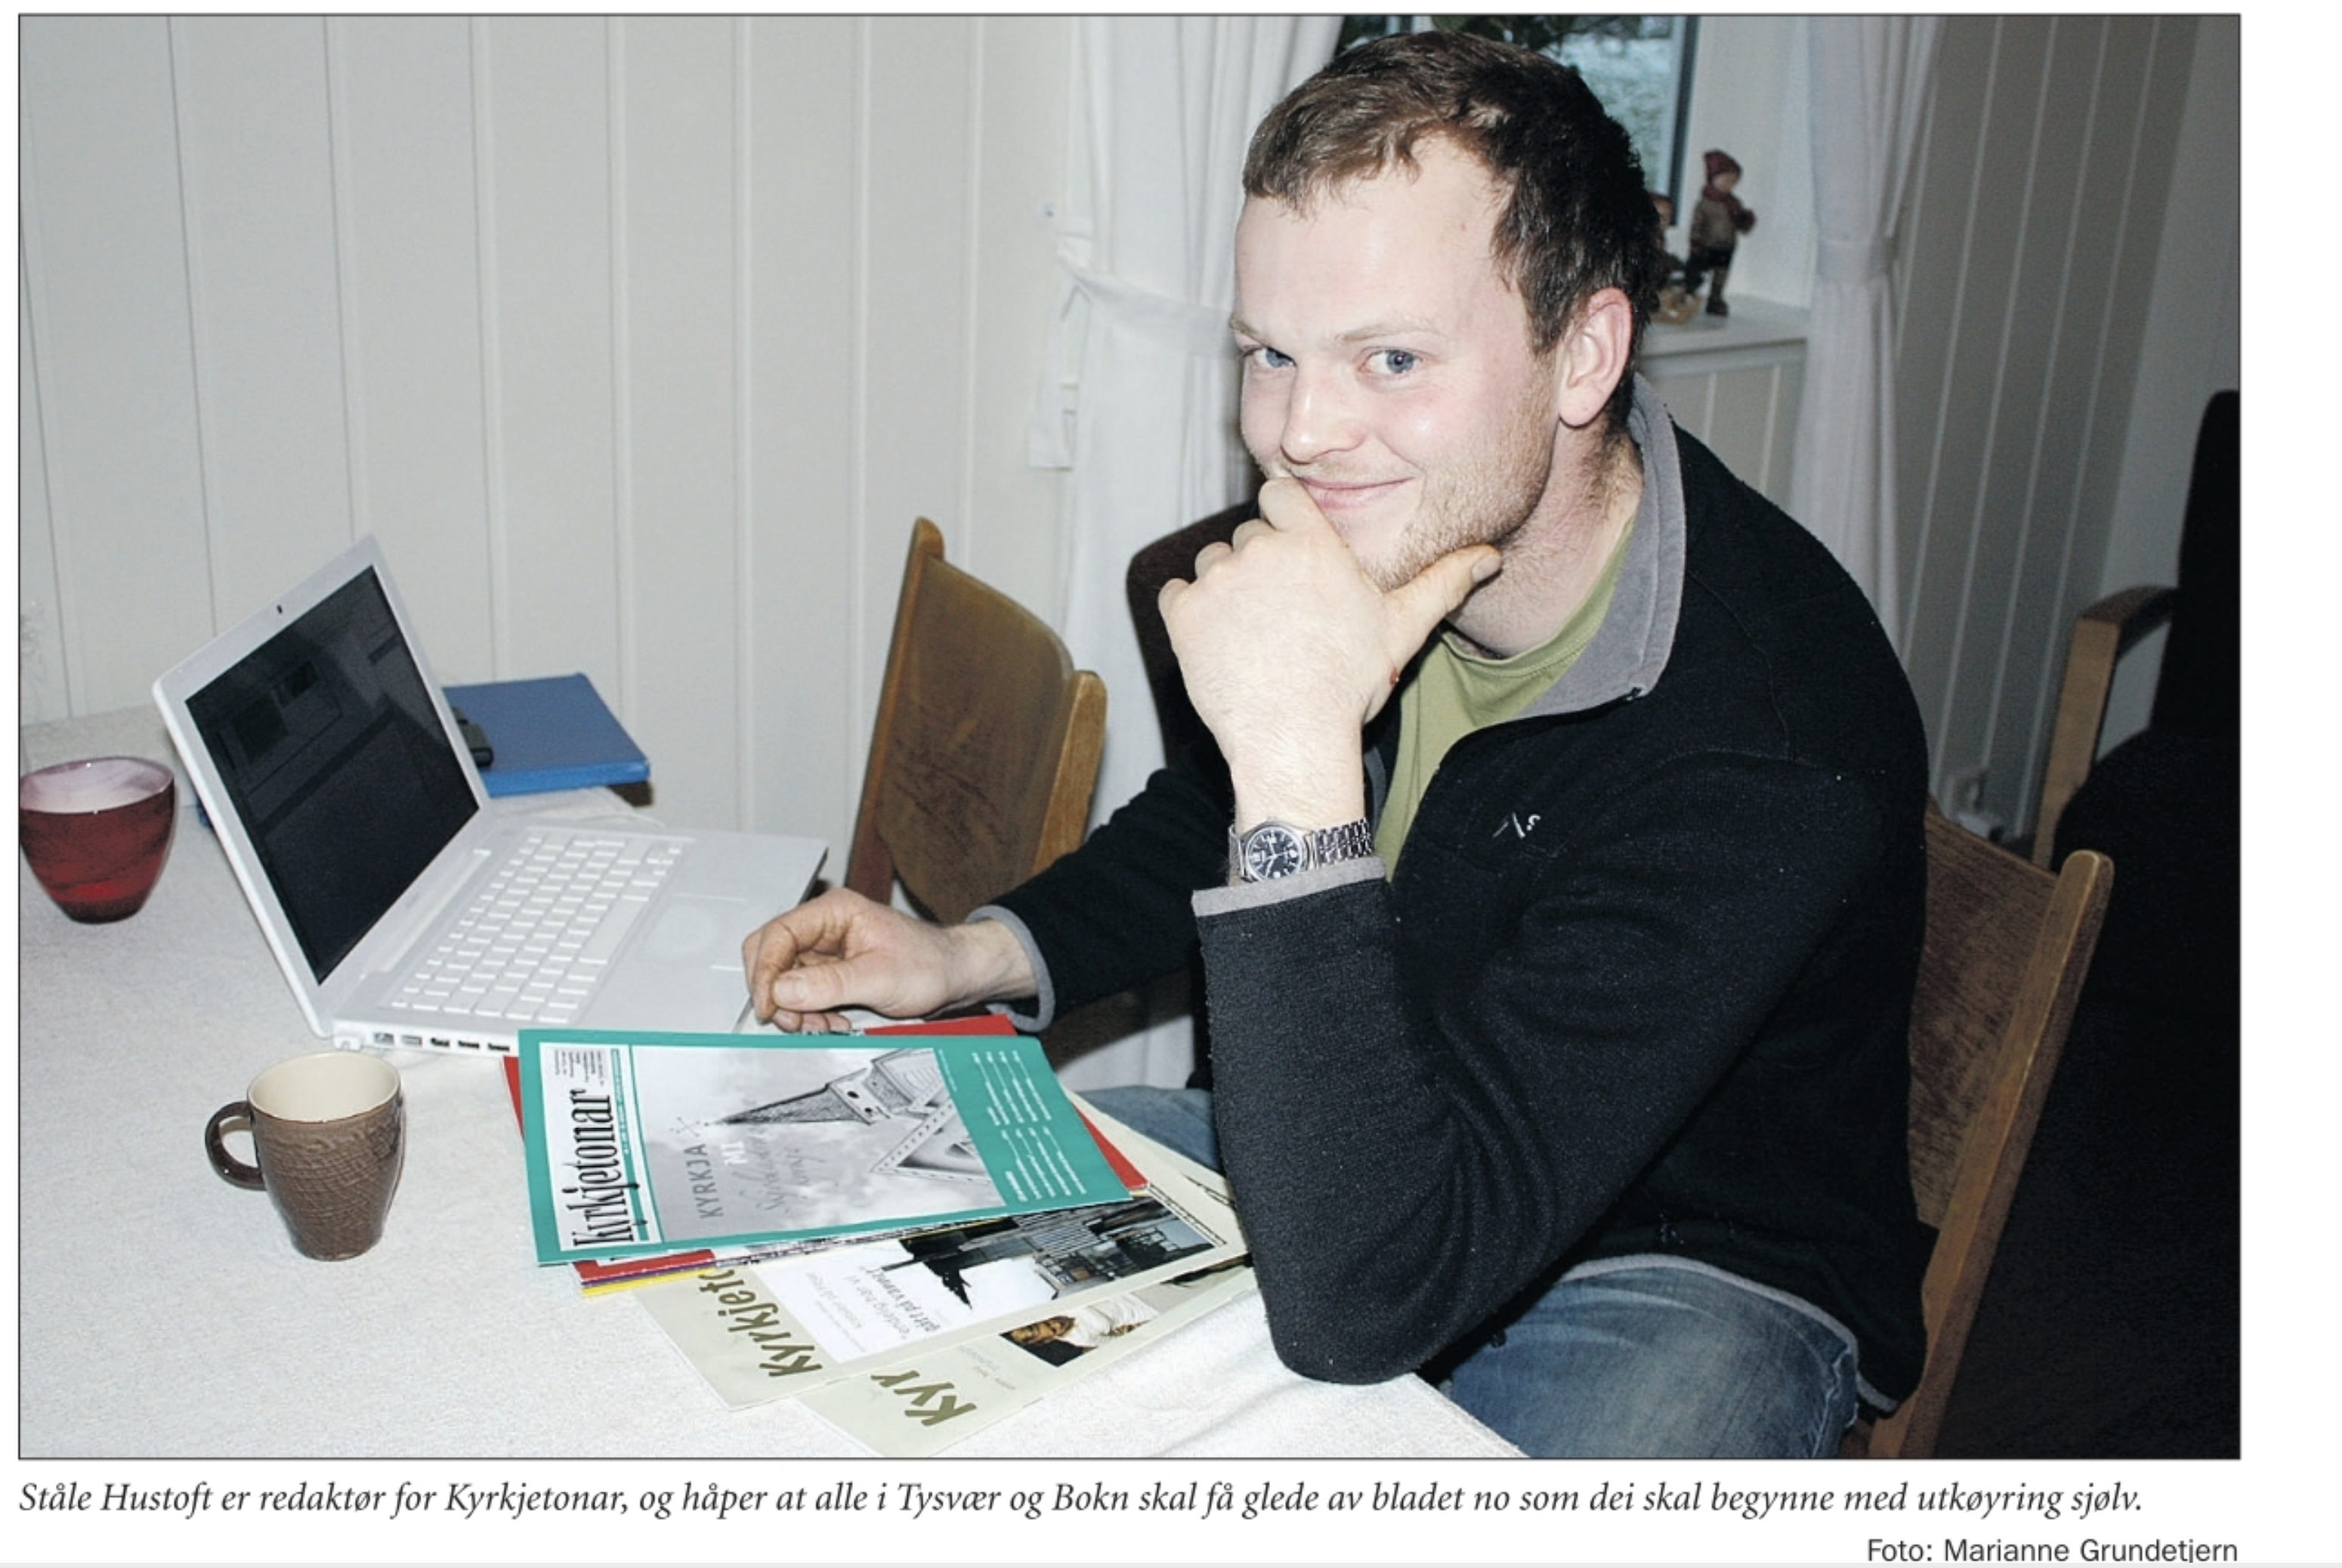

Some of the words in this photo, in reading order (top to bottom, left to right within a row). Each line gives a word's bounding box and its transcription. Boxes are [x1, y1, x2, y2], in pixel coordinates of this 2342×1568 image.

[562, 1088, 647, 1246] Kyrkjetonar
[684, 1143, 723, 1218] KYRKJA
[720, 1141, 748, 1165] MI
[870, 1370, 978, 1426] Kyr
